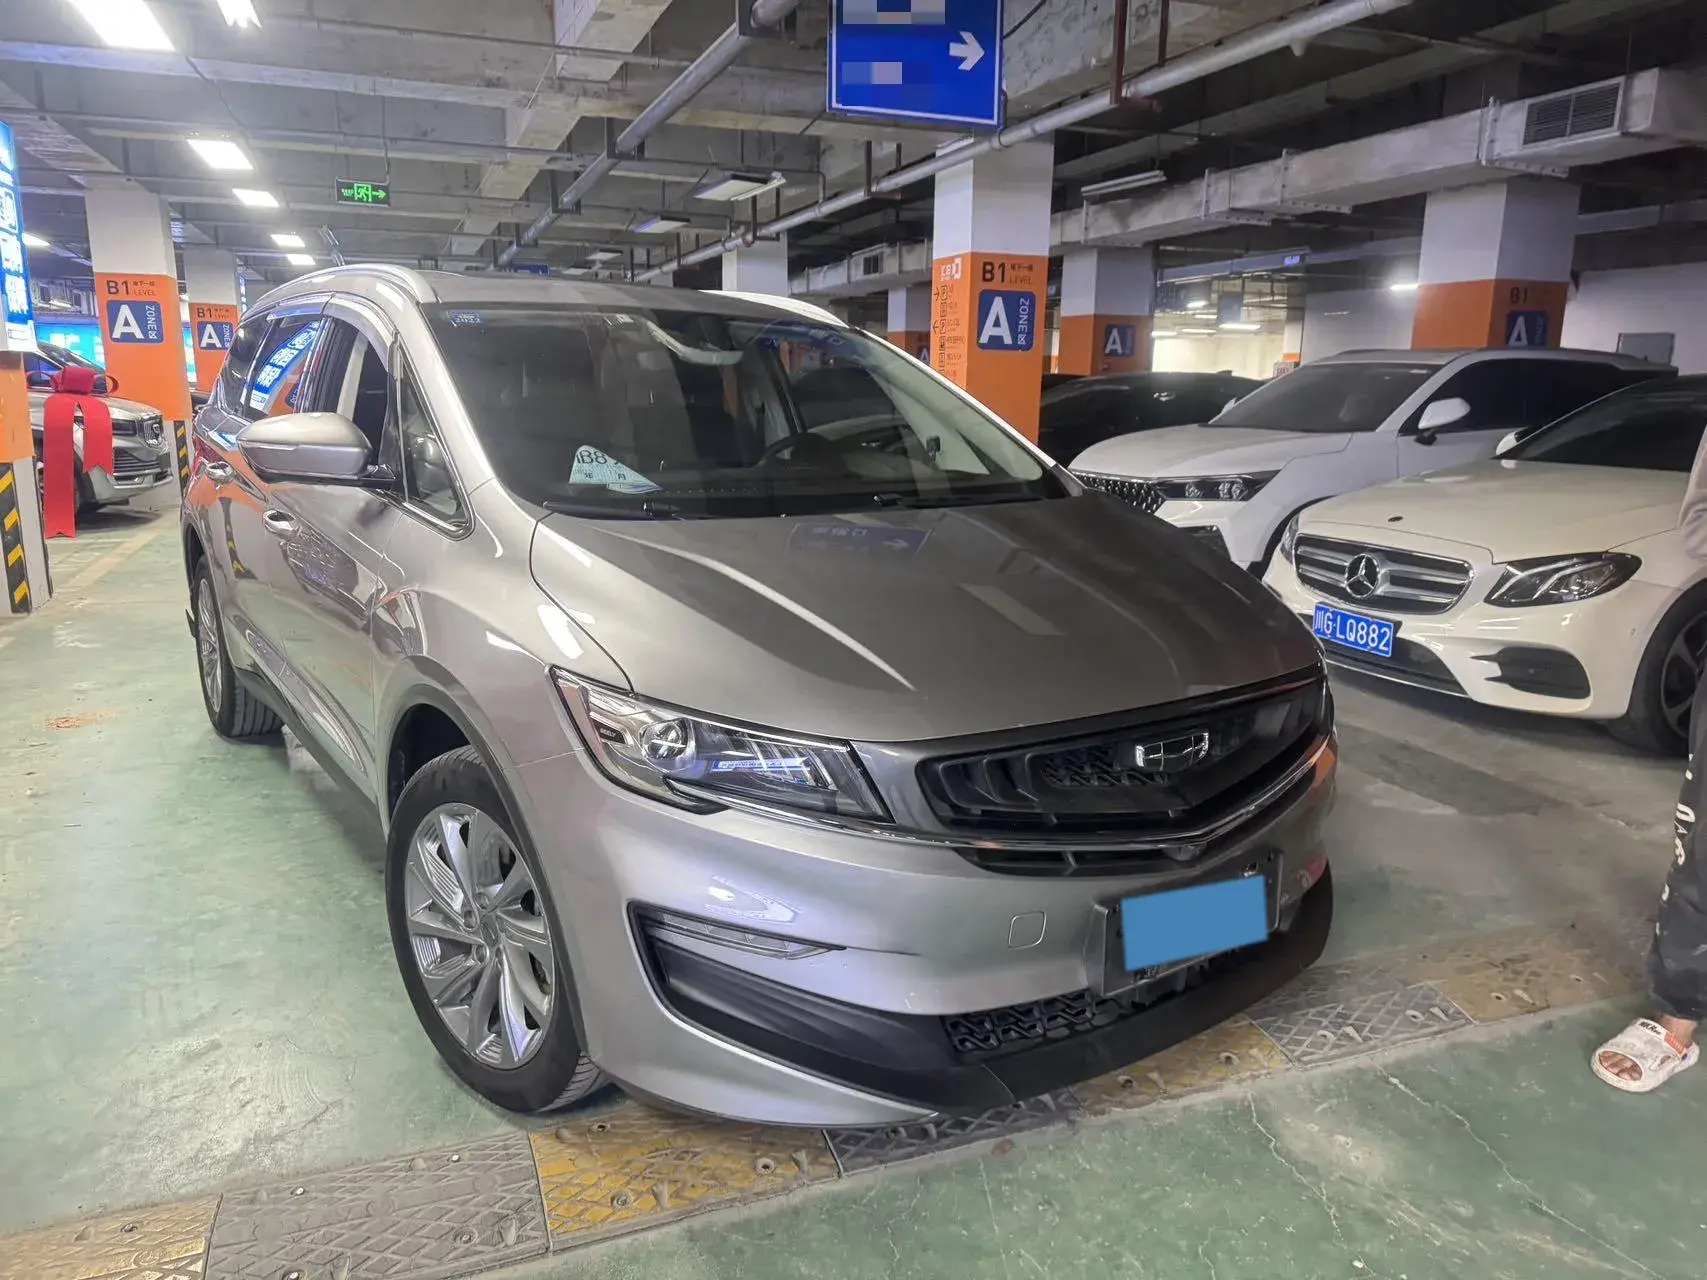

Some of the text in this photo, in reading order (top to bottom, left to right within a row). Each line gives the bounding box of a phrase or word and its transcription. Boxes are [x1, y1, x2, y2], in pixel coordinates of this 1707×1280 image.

[982, 262, 1006, 283] B1
[107, 280, 130, 295] B1
[1510, 286, 1528, 305] B1
[112, 304, 144, 339] A
[196, 307, 213, 319] B1
[979, 296, 1013, 345] A
[200, 323, 222, 348] A
[1104, 327, 1123, 355] A
[1508, 315, 1528, 347] A
